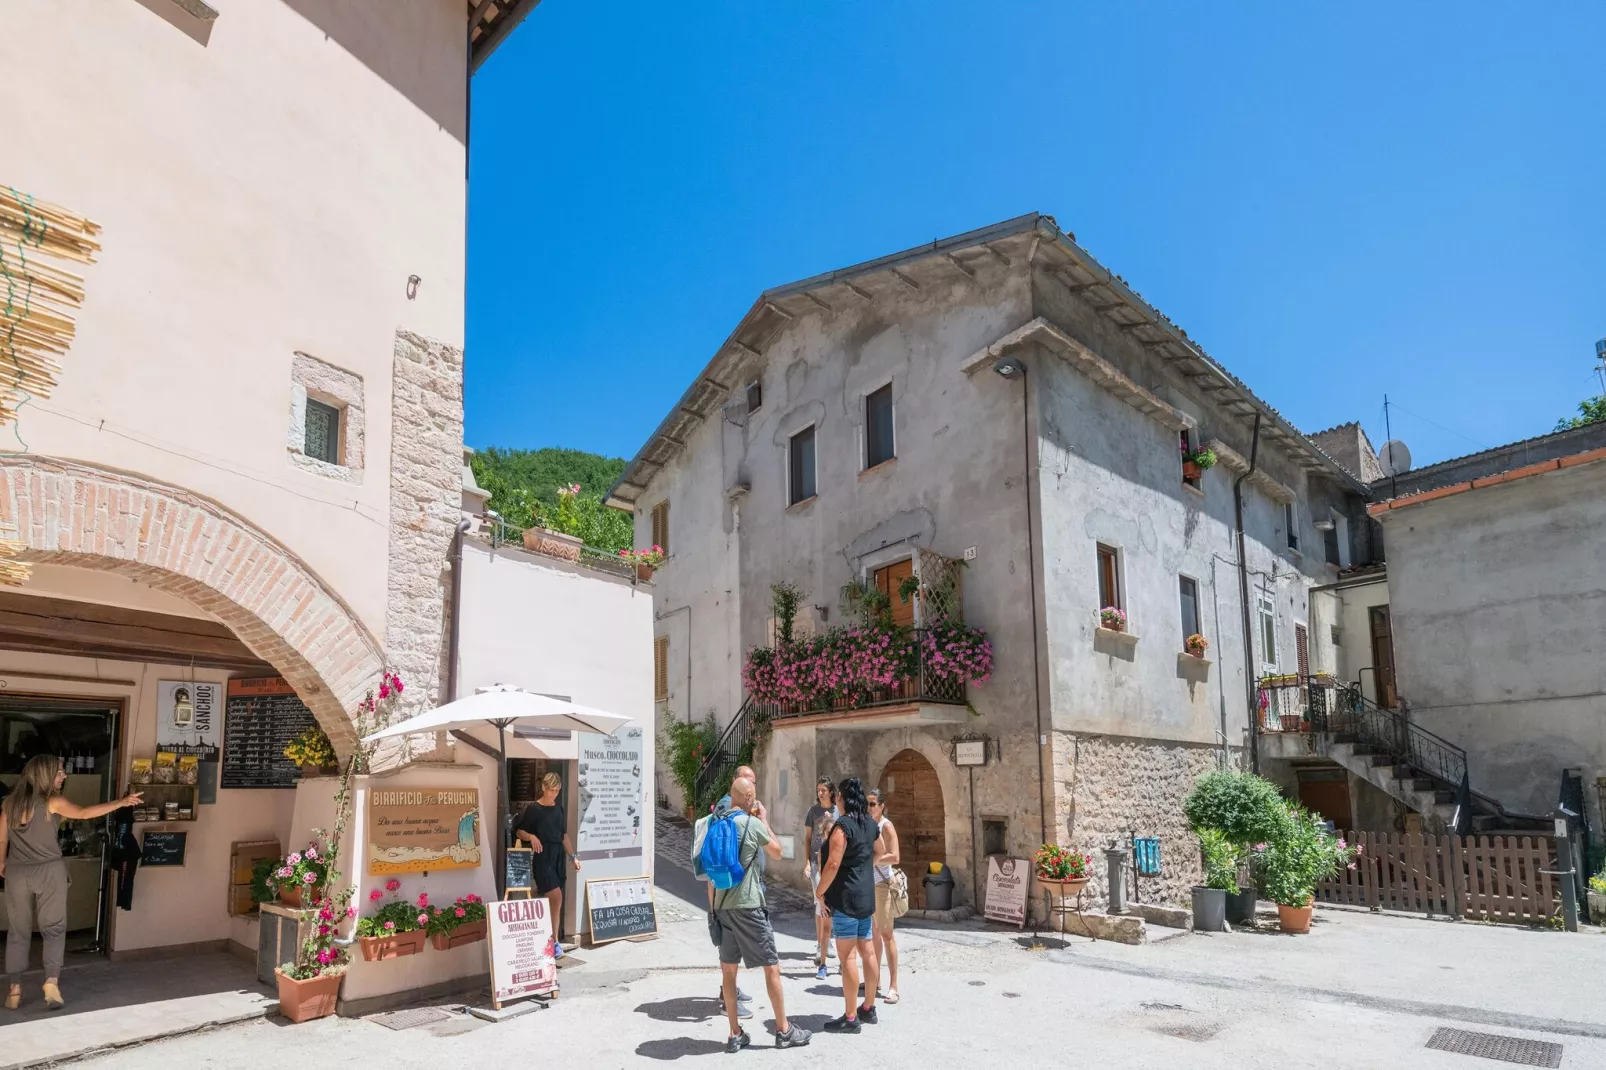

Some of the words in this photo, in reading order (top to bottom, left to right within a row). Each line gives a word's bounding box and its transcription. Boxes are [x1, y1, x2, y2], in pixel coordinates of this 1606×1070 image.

[966, 549, 974, 558] 13
[195, 685, 211, 731] SANCHOC
[606, 751, 639, 761] CIOCCOLATO
[373, 792, 422, 806] BIRRIFICIO
[438, 792, 476, 804] PERUGINI
[378, 816, 390, 825] Da
[404, 817, 422, 825] buona
[422, 818, 439, 827] acqua
[415, 828, 432, 836] buona
[993, 873, 1021, 885] Cioccolato
[498, 900, 544, 924] GELATO
[593, 909, 604, 920] FA
[606, 909, 615, 918] LA
[615, 906, 630, 917] COSA
[508, 922, 538, 932] ARTIGIANALE
[502, 933, 527, 941] CIOCCOLATO
